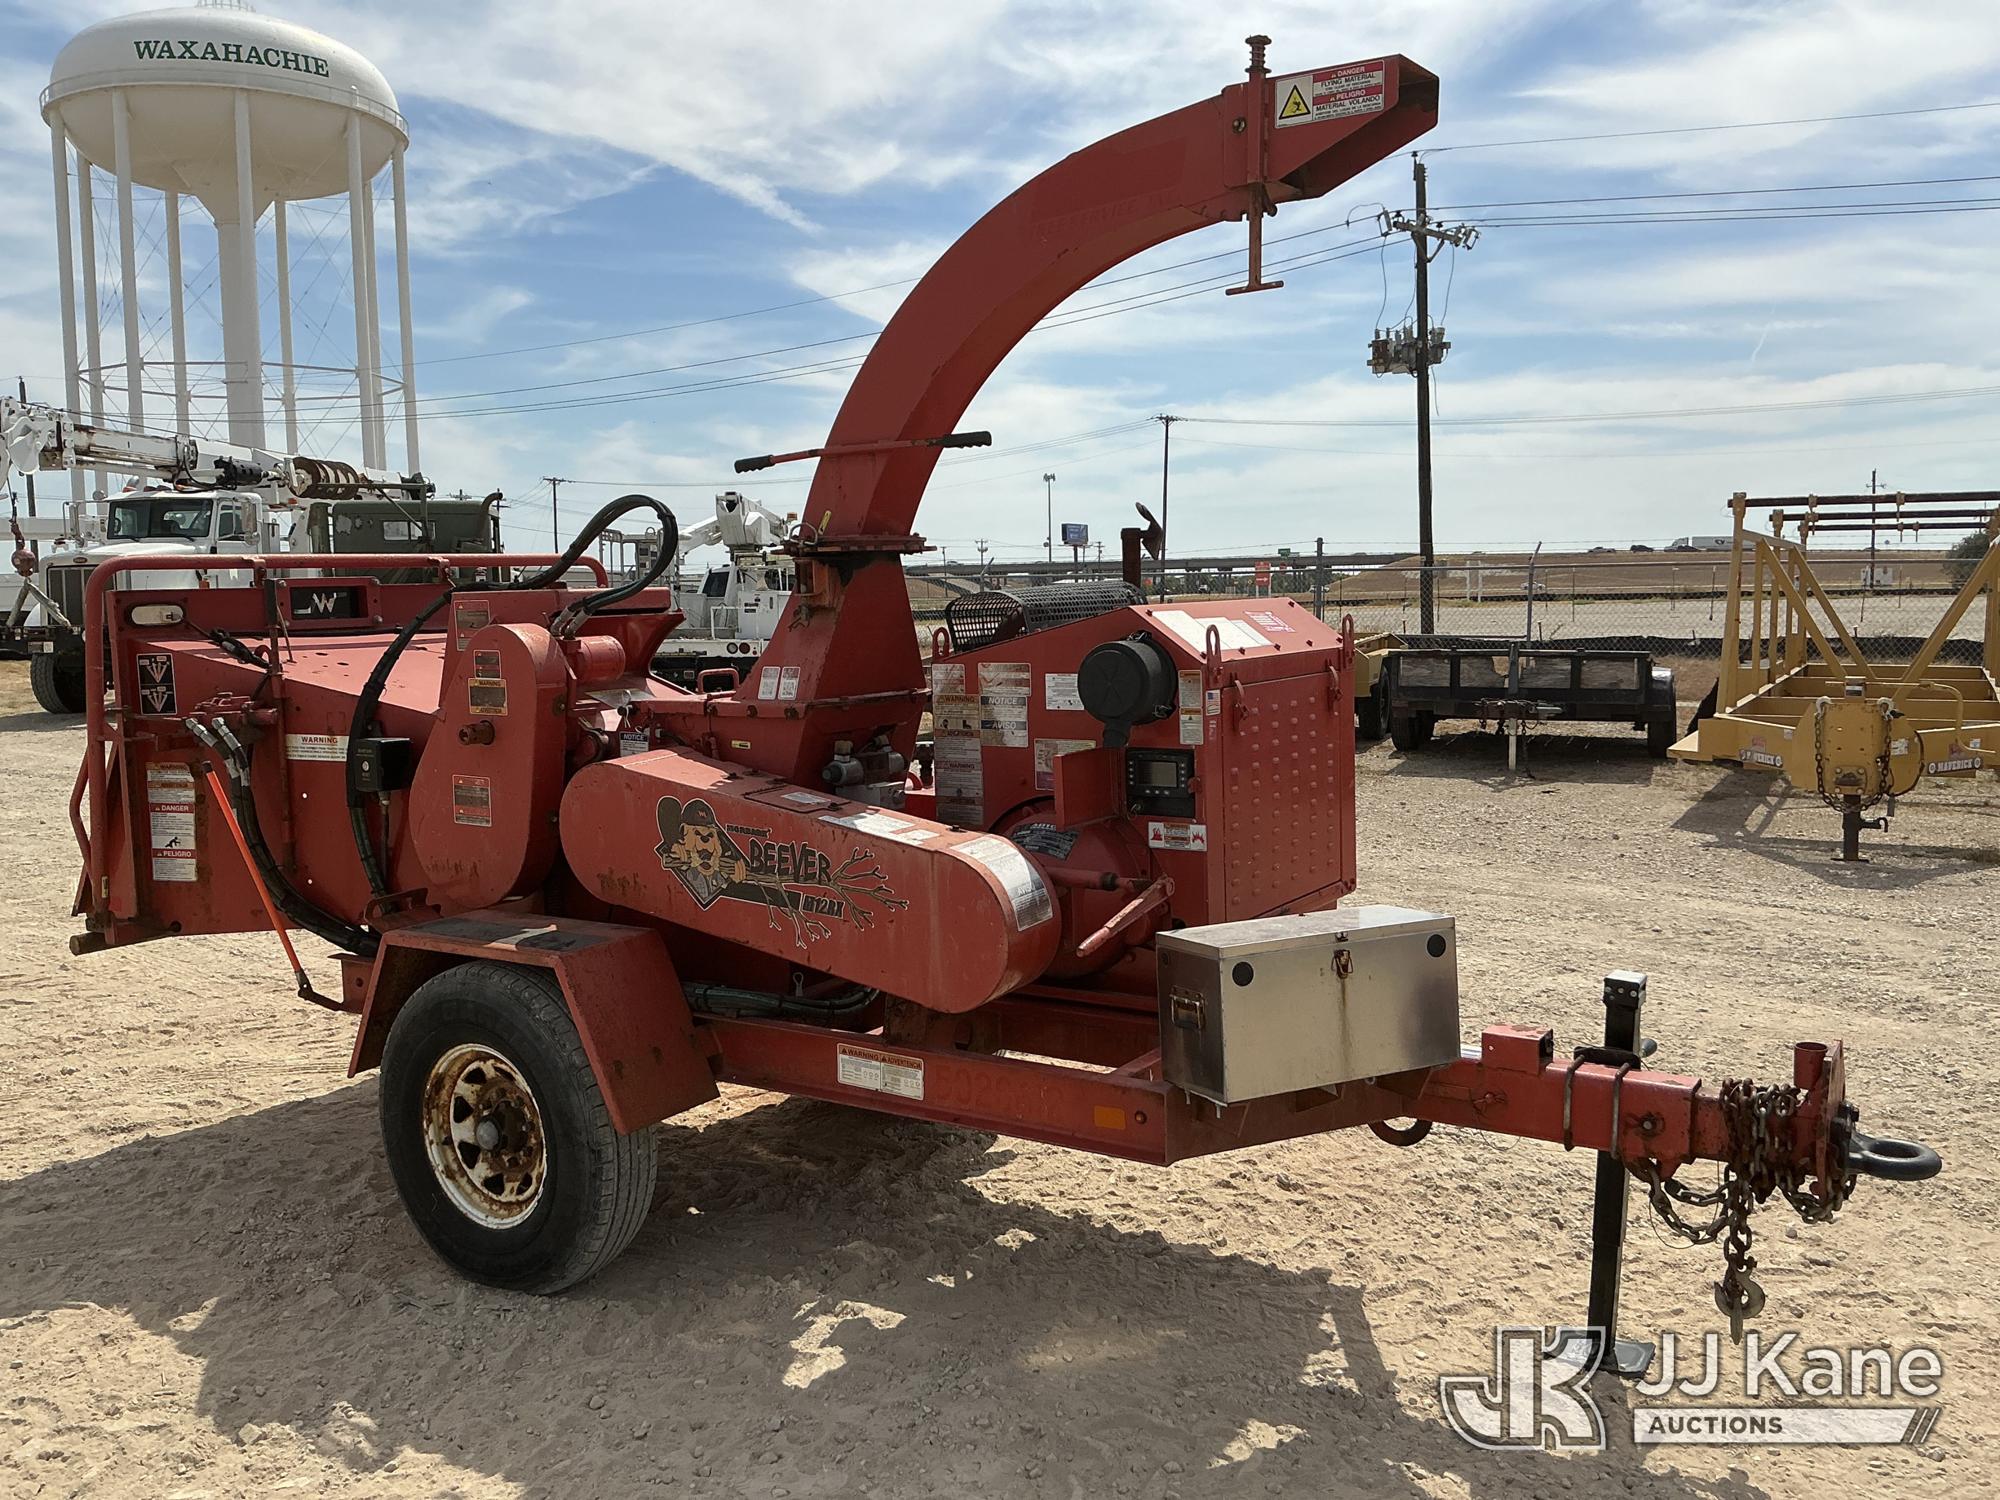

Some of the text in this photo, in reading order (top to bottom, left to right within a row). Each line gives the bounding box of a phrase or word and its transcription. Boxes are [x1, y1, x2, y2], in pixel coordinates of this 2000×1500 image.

[133, 40, 330, 78] WAXAHACHIE
[1337, 66, 1366, 77] DANGER
[1320, 79, 1343, 88] FLYING
[1344, 72, 1376, 83] MATERIAL
[1336, 89, 1366, 100] PELIGRO
[1316, 101, 1346, 111] MATERIAL
[1349, 95, 1381, 106] VOLANDO
[988, 697, 1018, 705] NOTICE
[992, 721, 1018, 730] AVISO
[301, 736, 338, 744] WARNING
[623, 733, 645, 741] NOTICE
[1937, 759, 1973, 772] MAVERICK
[163, 850, 192, 858] PELIGRO
[749, 838, 832, 884] BEEVER
[848, 1049, 879, 1061] WARNING
